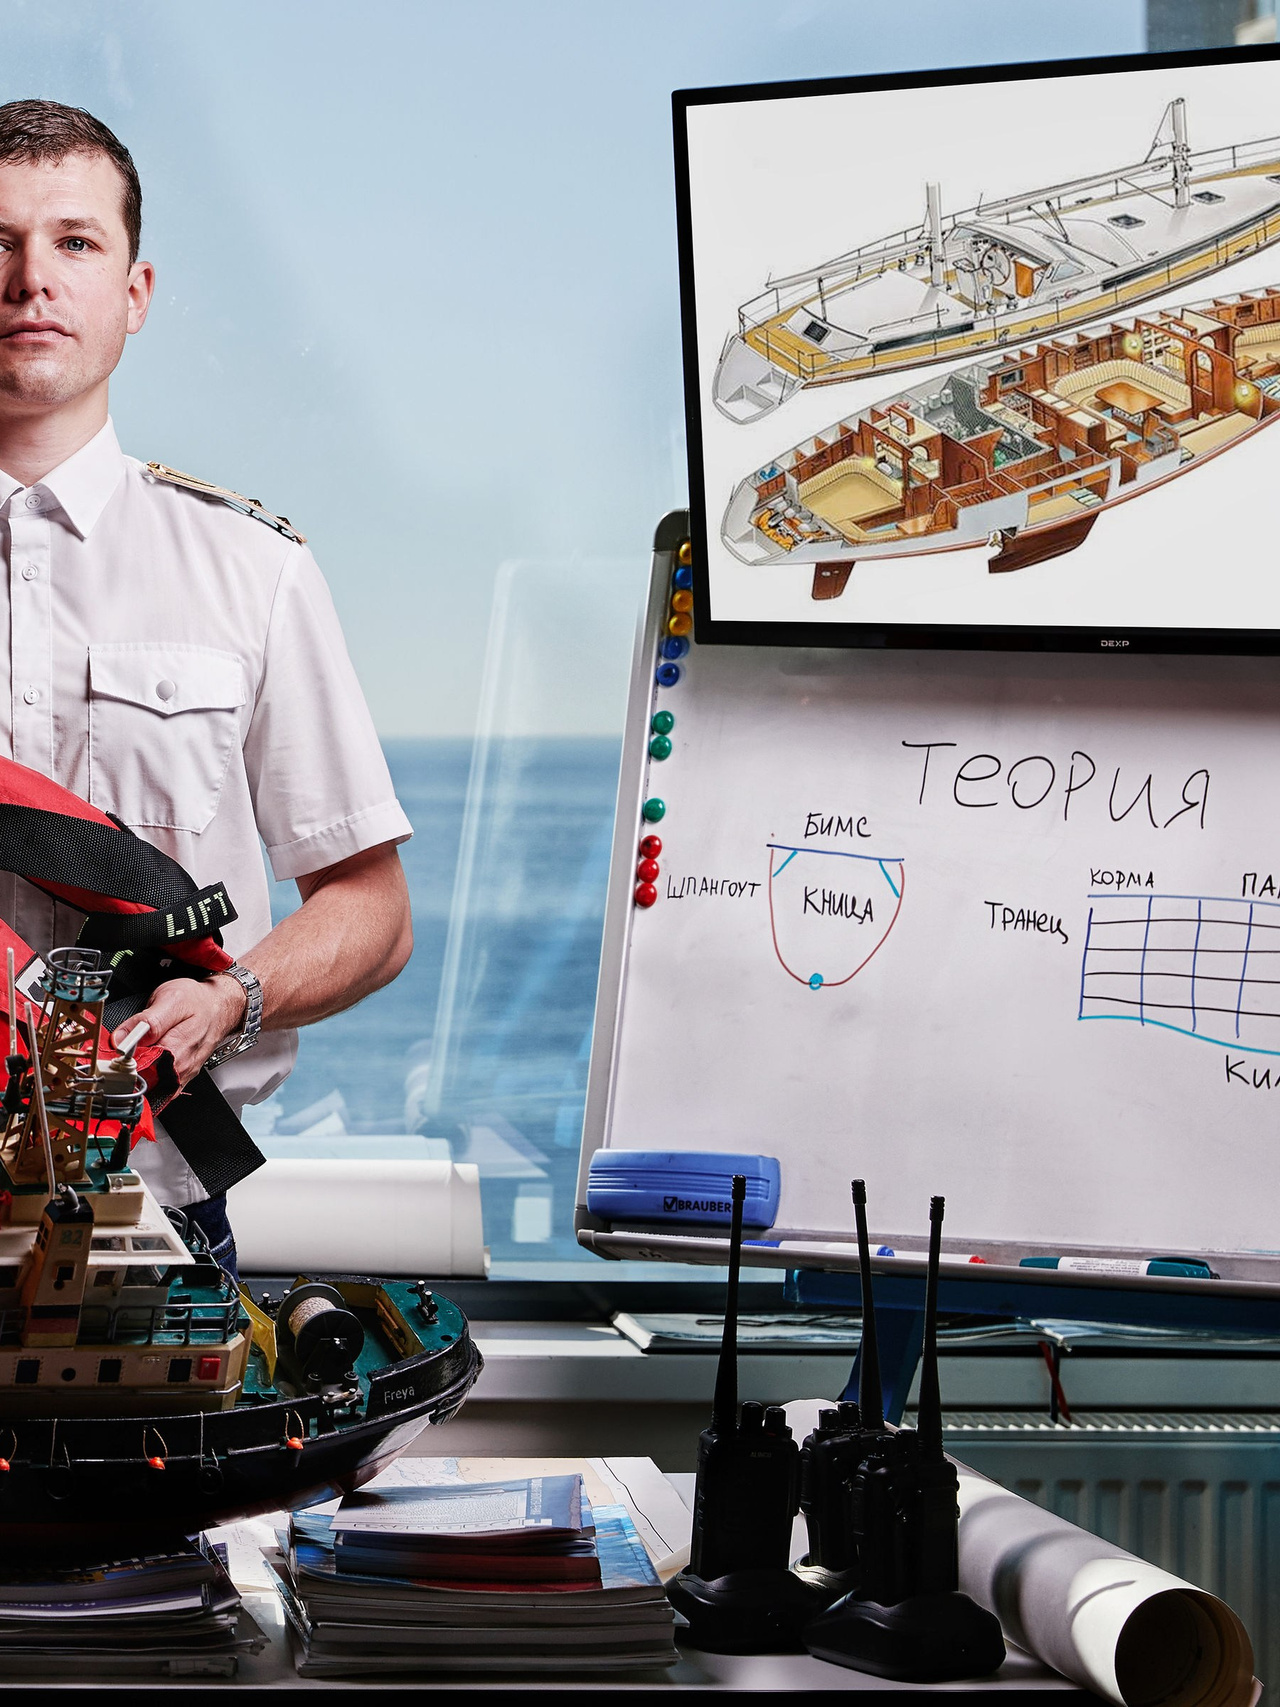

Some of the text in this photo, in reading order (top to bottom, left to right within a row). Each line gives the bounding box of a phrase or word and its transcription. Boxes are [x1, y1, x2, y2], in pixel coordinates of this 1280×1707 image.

[804, 813, 872, 839] БИМС
[666, 876, 762, 900] ШПАНГОУТ
[1090, 869, 1155, 890] КОРМА
[1242, 872, 1280, 899] ПА
[166, 892, 228, 938] LIFT
[804, 886, 875, 925] КНИЦА
[384, 1386, 415, 1405] Freya
